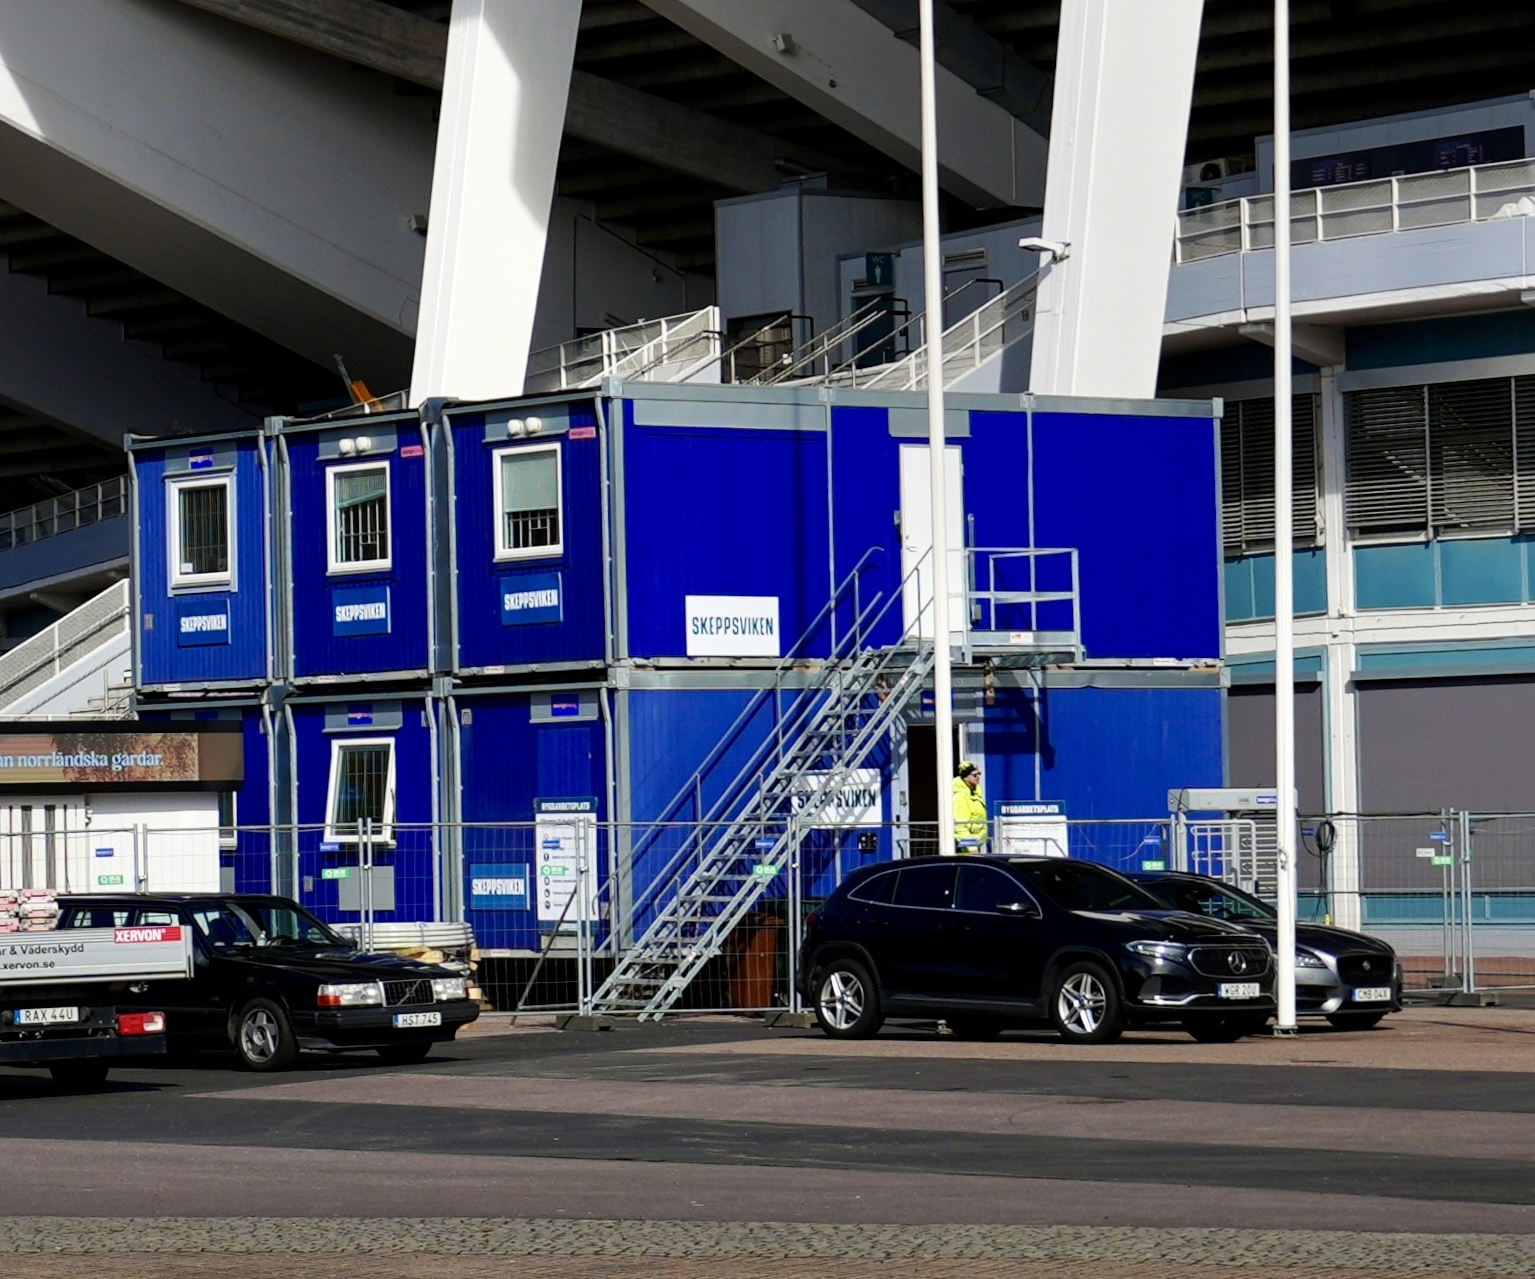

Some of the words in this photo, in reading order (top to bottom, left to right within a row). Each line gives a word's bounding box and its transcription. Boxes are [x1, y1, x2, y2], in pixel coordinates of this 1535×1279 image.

[503, 589, 559, 611] SKEPPSVIKEN
[335, 601, 386, 622] SKEPPSVIKEN
[180, 613, 227, 633] SKEPPSVIKEN
[692, 616, 774, 635] SKEPPSVIKEN
[17, 751, 108, 768] norrländska
[111, 752, 164, 772] gårdar.
[472, 878, 525, 896] SKEPPSVIKEN
[9, 945, 17, 956] &
[21, 943, 85, 956] Väderskydd
[24, 1010, 48, 1022] RAX
[50, 1008, 75, 1020] 44U
[401, 1015, 419, 1025] HST
[421, 1013, 438, 1025] 745
